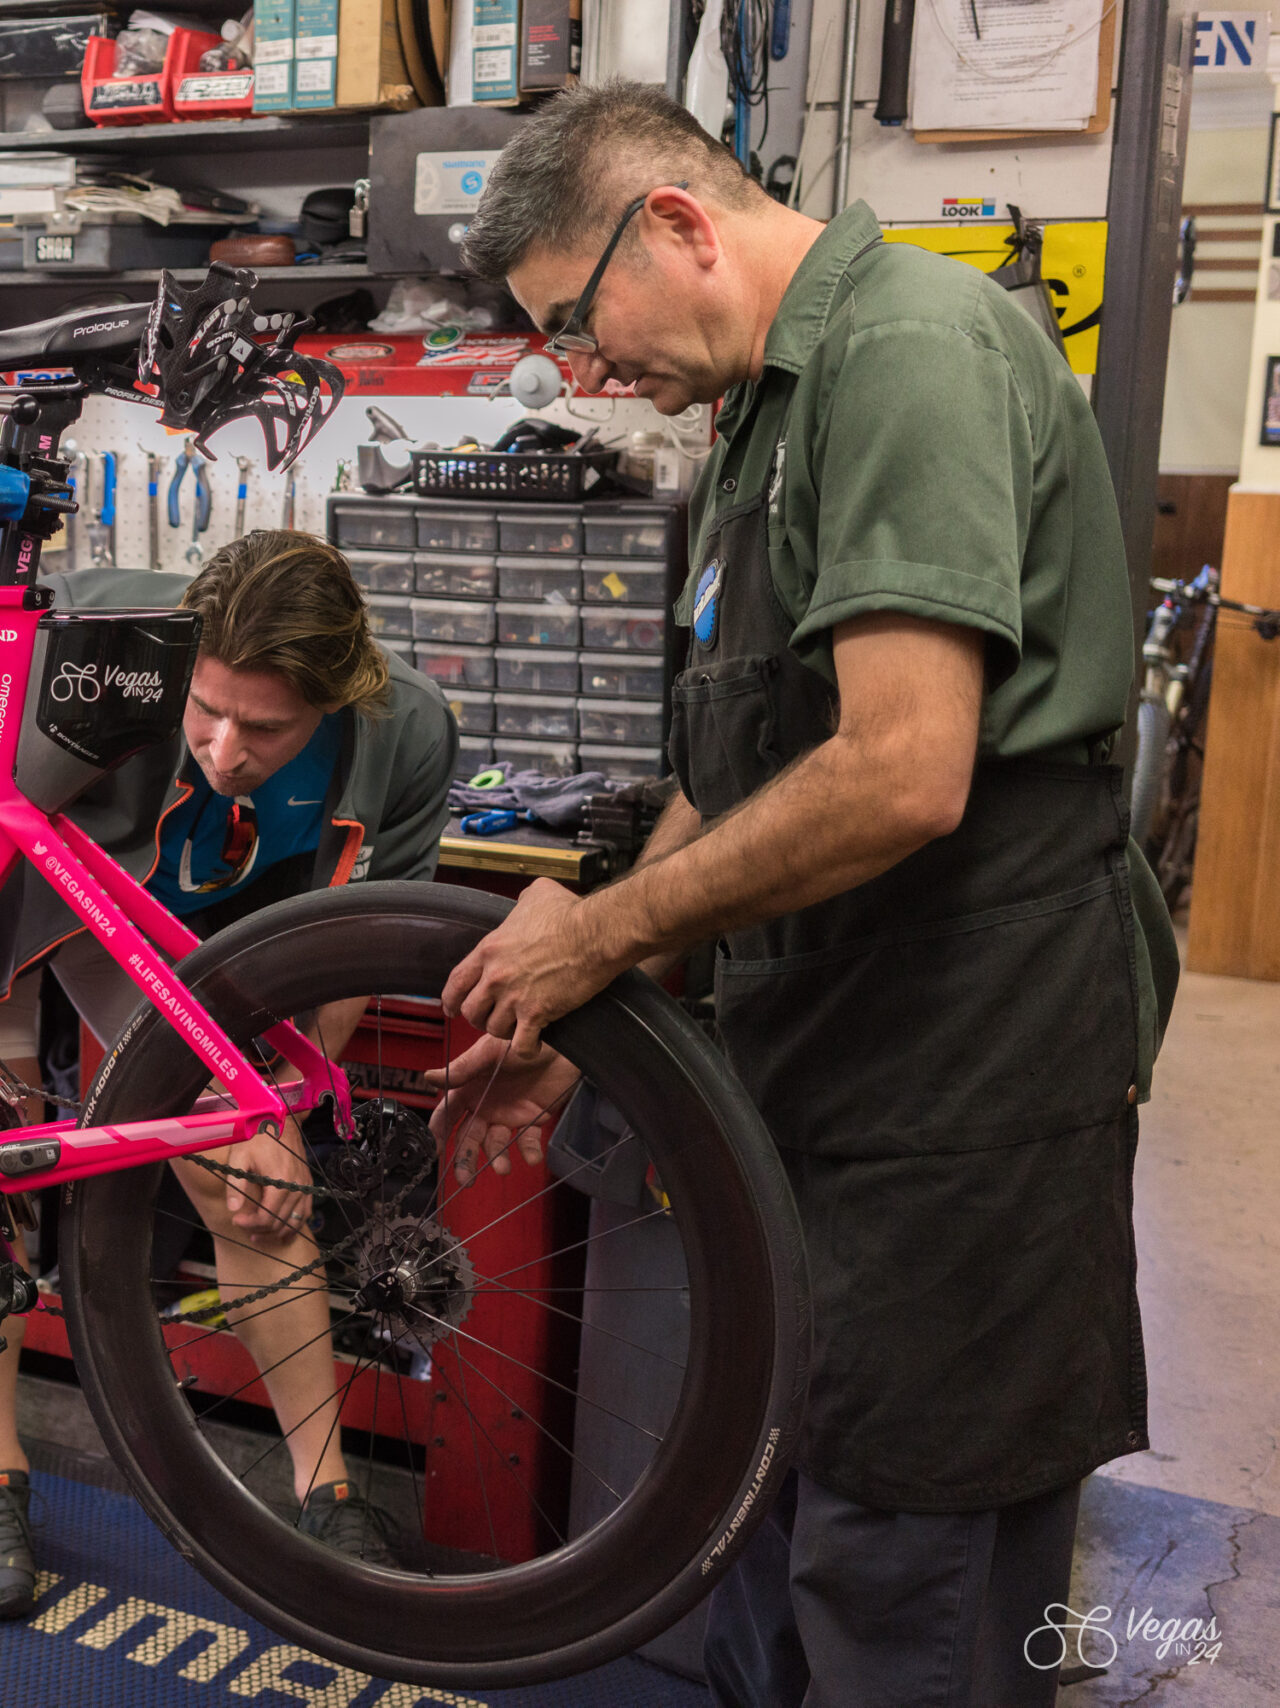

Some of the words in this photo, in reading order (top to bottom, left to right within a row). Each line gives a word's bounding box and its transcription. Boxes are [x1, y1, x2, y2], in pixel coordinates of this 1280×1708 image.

[942, 206, 980, 216] LOOK
[73, 318, 129, 338] Prologue
[104, 386, 140, 401] PROFILE
[104, 665, 162, 698] Vegas
[132, 687, 144, 697] IN
[141, 688, 164, 703] 24
[45, 856, 117, 938] @VEGASIN24
[128, 953, 239, 1081] #LIFESAVINGMILES
[711, 1442, 775, 1557] CONTINENTAL
